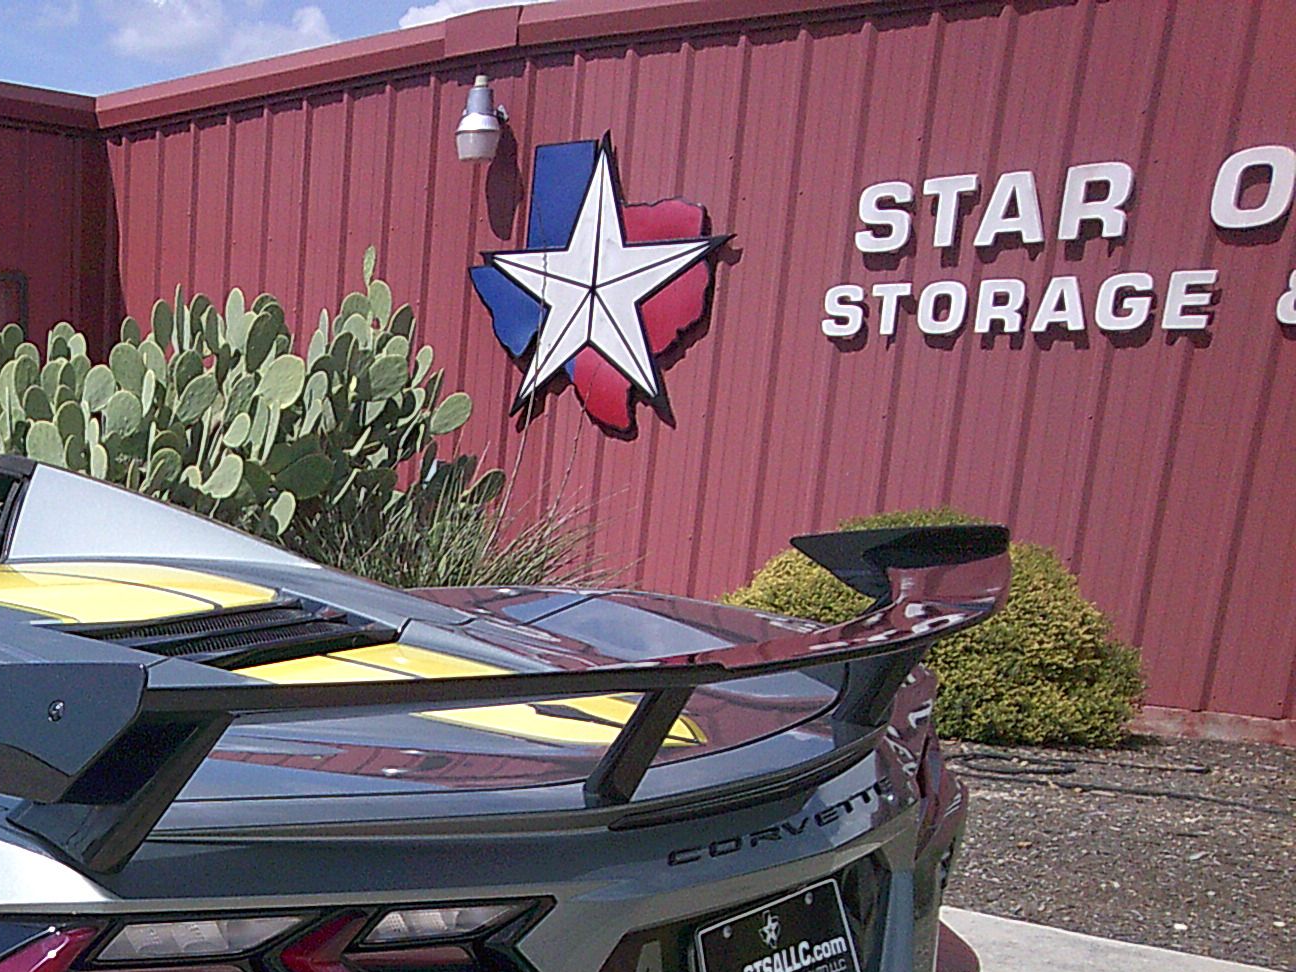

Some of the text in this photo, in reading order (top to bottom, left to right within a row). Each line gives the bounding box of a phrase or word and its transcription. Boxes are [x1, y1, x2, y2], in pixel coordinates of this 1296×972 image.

[855, 161, 1134, 253] STAR
[821, 269, 1219, 337] STORAGE
[667, 778, 892, 866] CORVETTE
